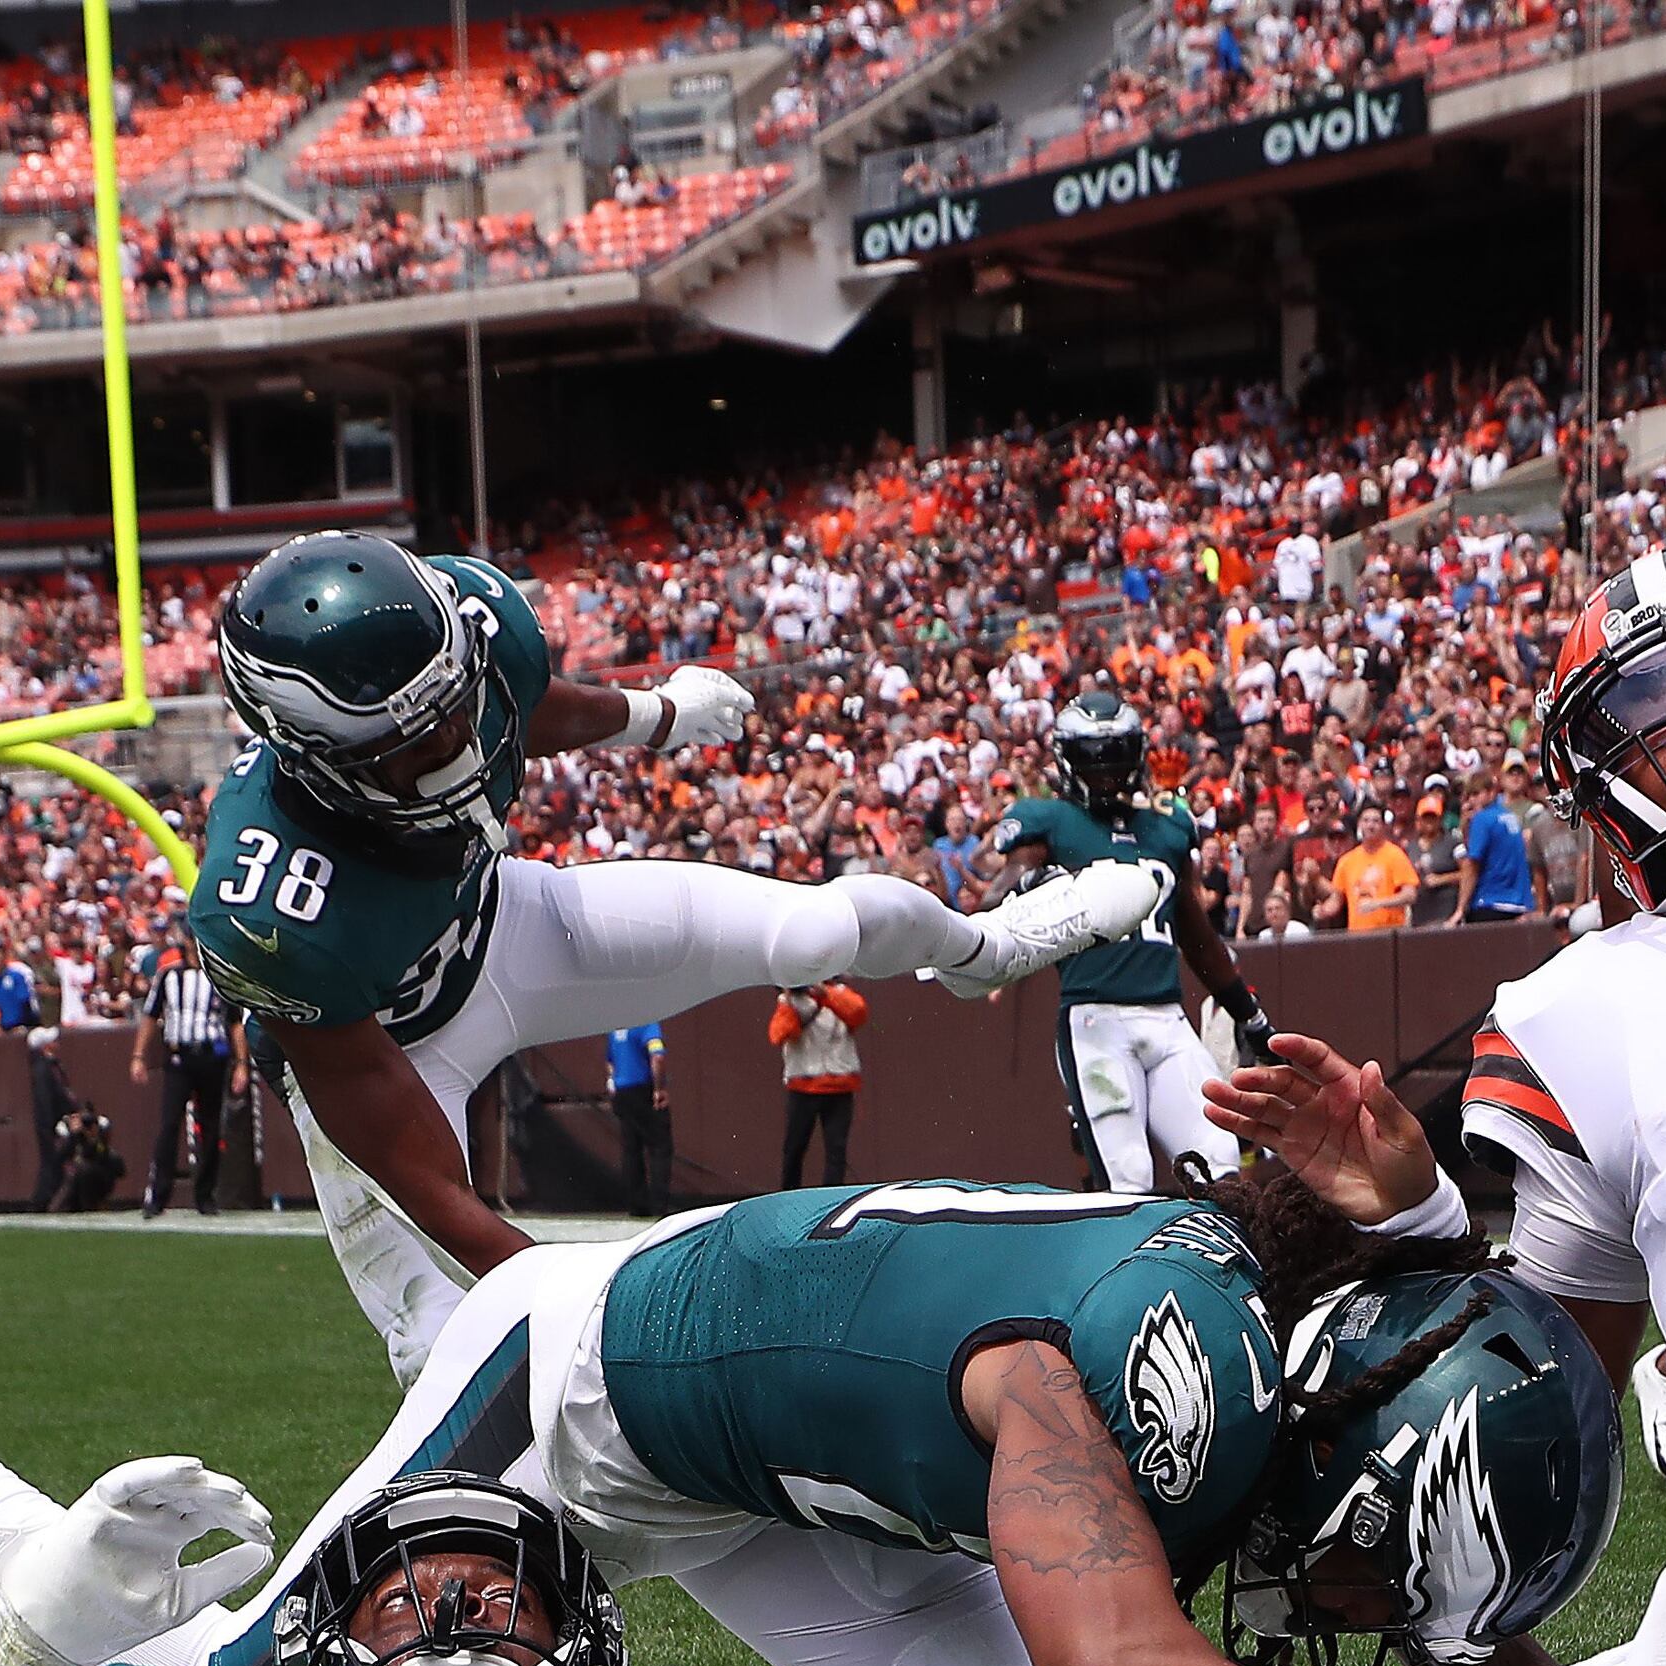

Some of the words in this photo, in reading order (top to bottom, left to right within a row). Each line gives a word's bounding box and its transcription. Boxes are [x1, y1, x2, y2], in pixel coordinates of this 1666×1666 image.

[1264, 90, 1400, 166] evolv
[1053, 147, 1179, 216] evolv
[863, 196, 978, 262] evolv
[219, 827, 334, 922] 38
